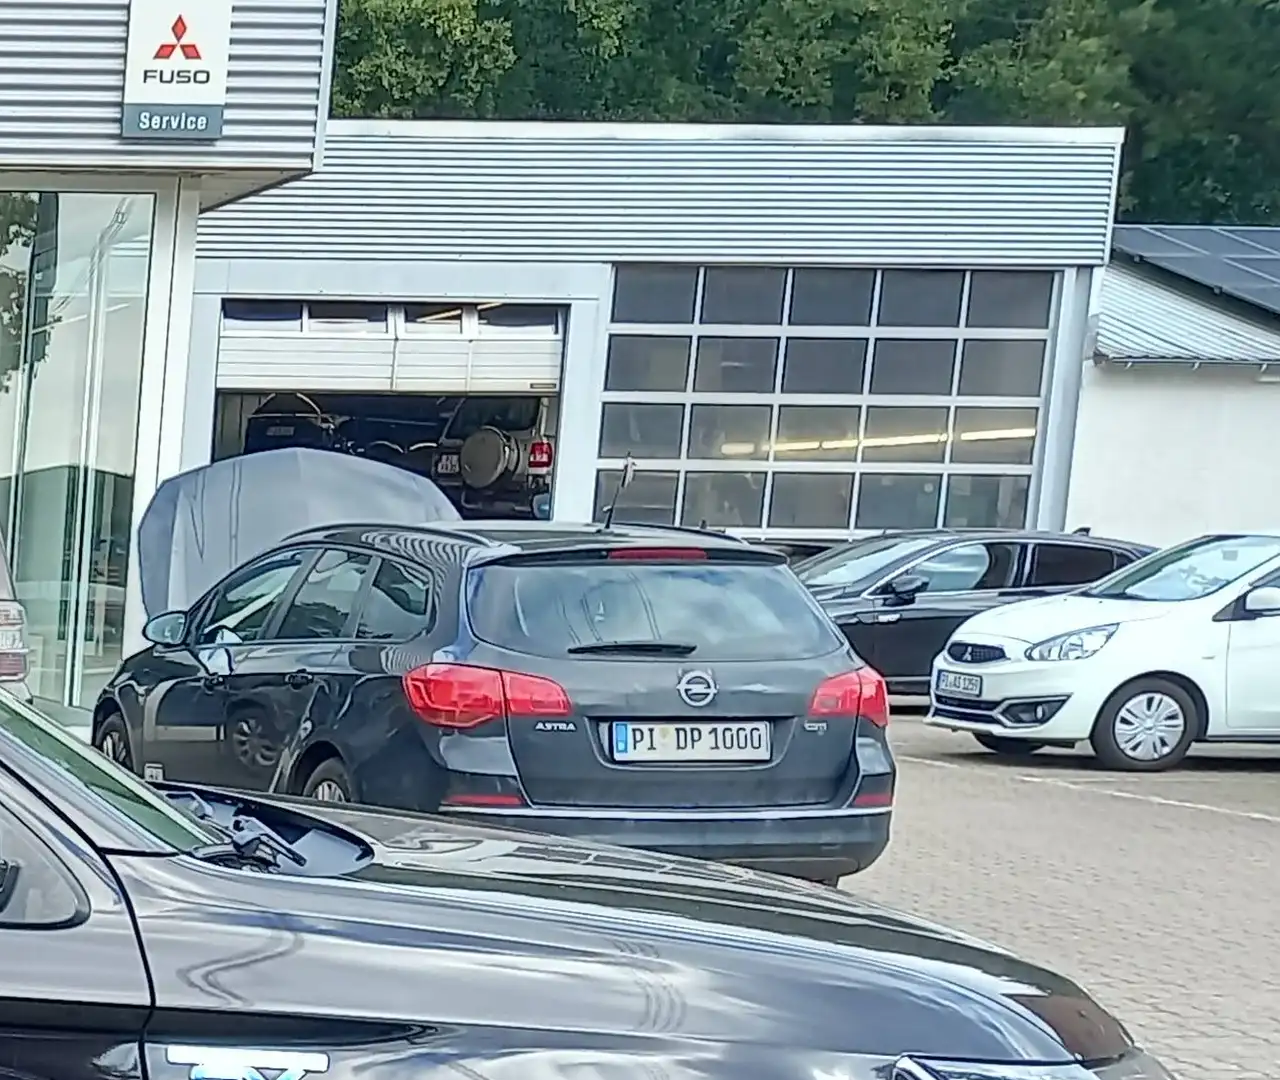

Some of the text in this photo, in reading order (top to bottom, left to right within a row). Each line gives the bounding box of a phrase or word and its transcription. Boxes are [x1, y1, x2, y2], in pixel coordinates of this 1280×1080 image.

[143, 70, 211, 84] FUSO
[139, 111, 208, 131] Service
[534, 721, 577, 731] ASTRA
[631, 727, 761, 751] PI DP 1000
